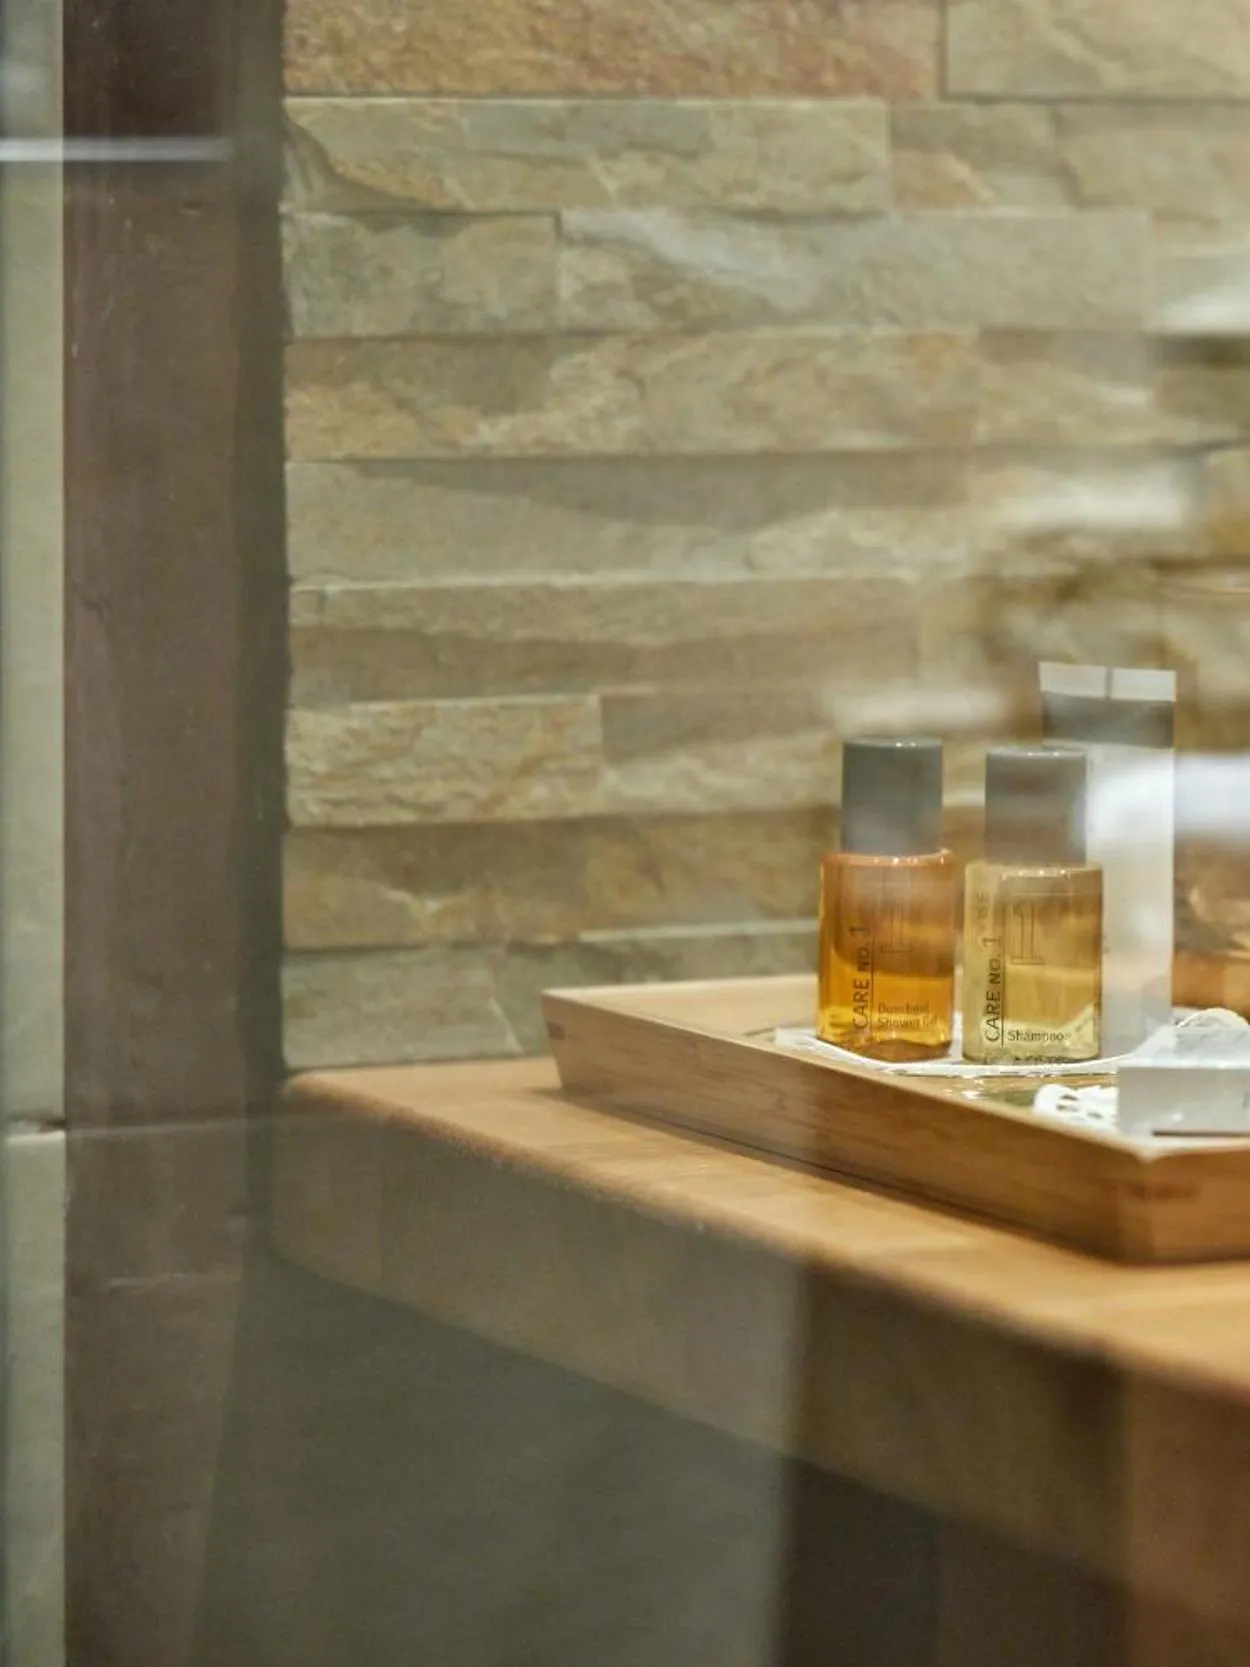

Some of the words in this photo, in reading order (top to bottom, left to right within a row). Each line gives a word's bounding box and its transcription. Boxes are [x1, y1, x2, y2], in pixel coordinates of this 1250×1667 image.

[982, 935, 1001, 948] 1
[853, 979, 869, 1029] CARE
[985, 990, 1001, 1042] CARE
